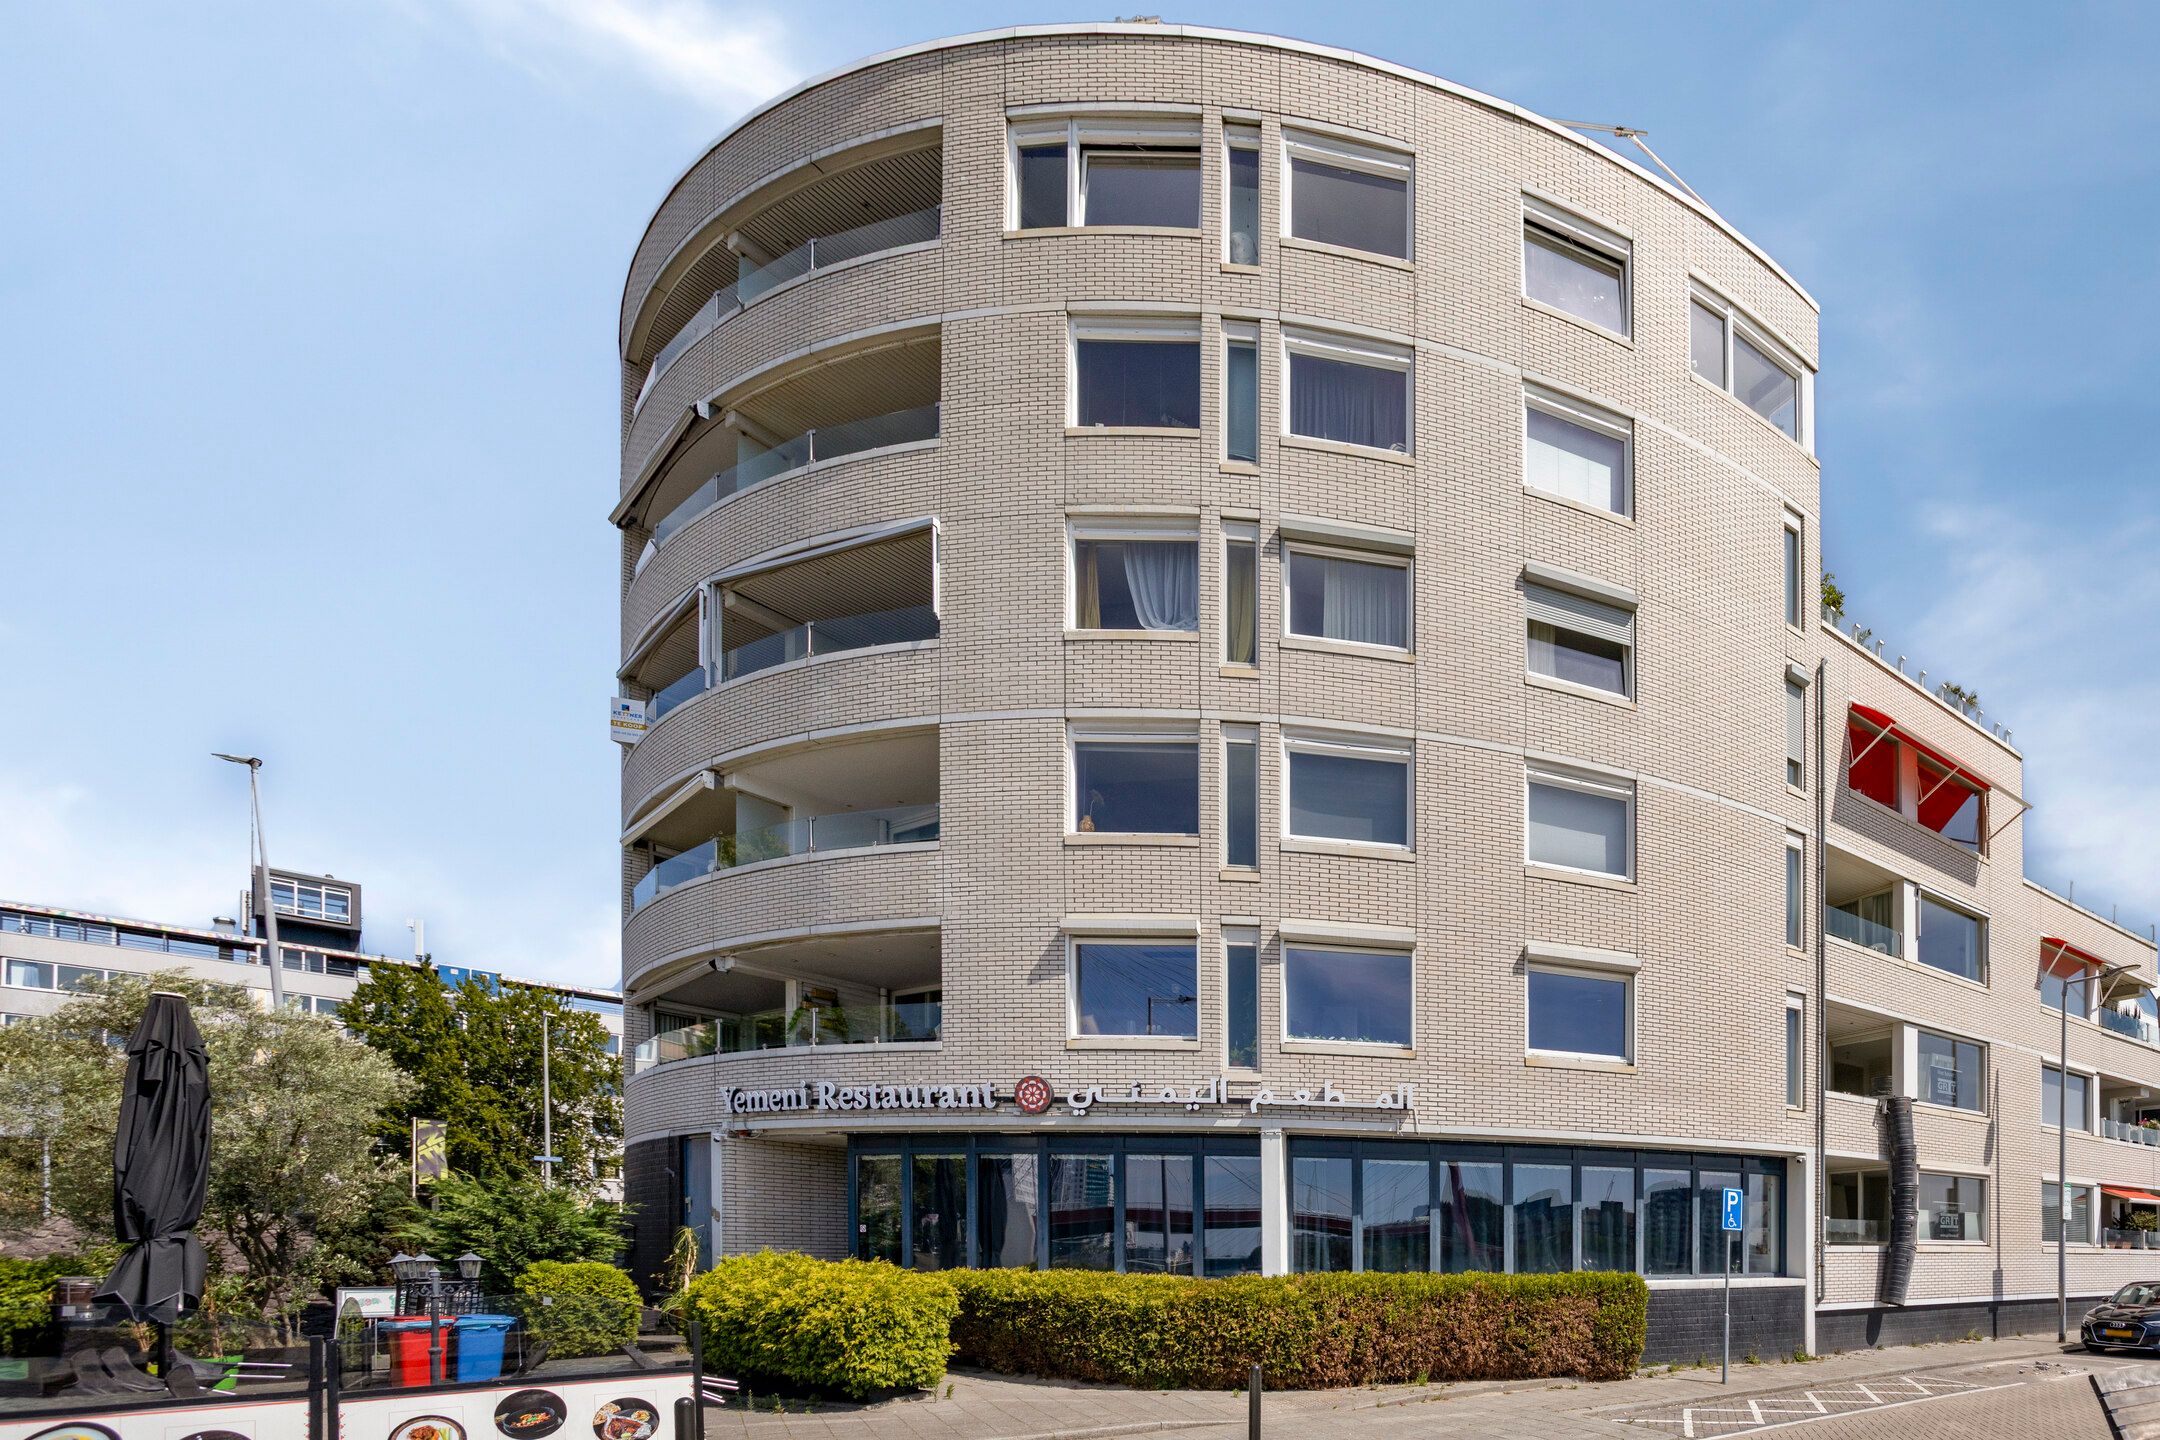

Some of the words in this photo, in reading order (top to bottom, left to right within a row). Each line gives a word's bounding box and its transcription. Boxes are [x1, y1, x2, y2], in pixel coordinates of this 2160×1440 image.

[719, 1080, 809, 1113] Yemeni
[816, 1081, 997, 1111] Restaurant
[1067, 1078, 1229, 1117] اليمني
[1250, 1079, 1414, 1114] المطعم
[1727, 1191, 1739, 1212] P
